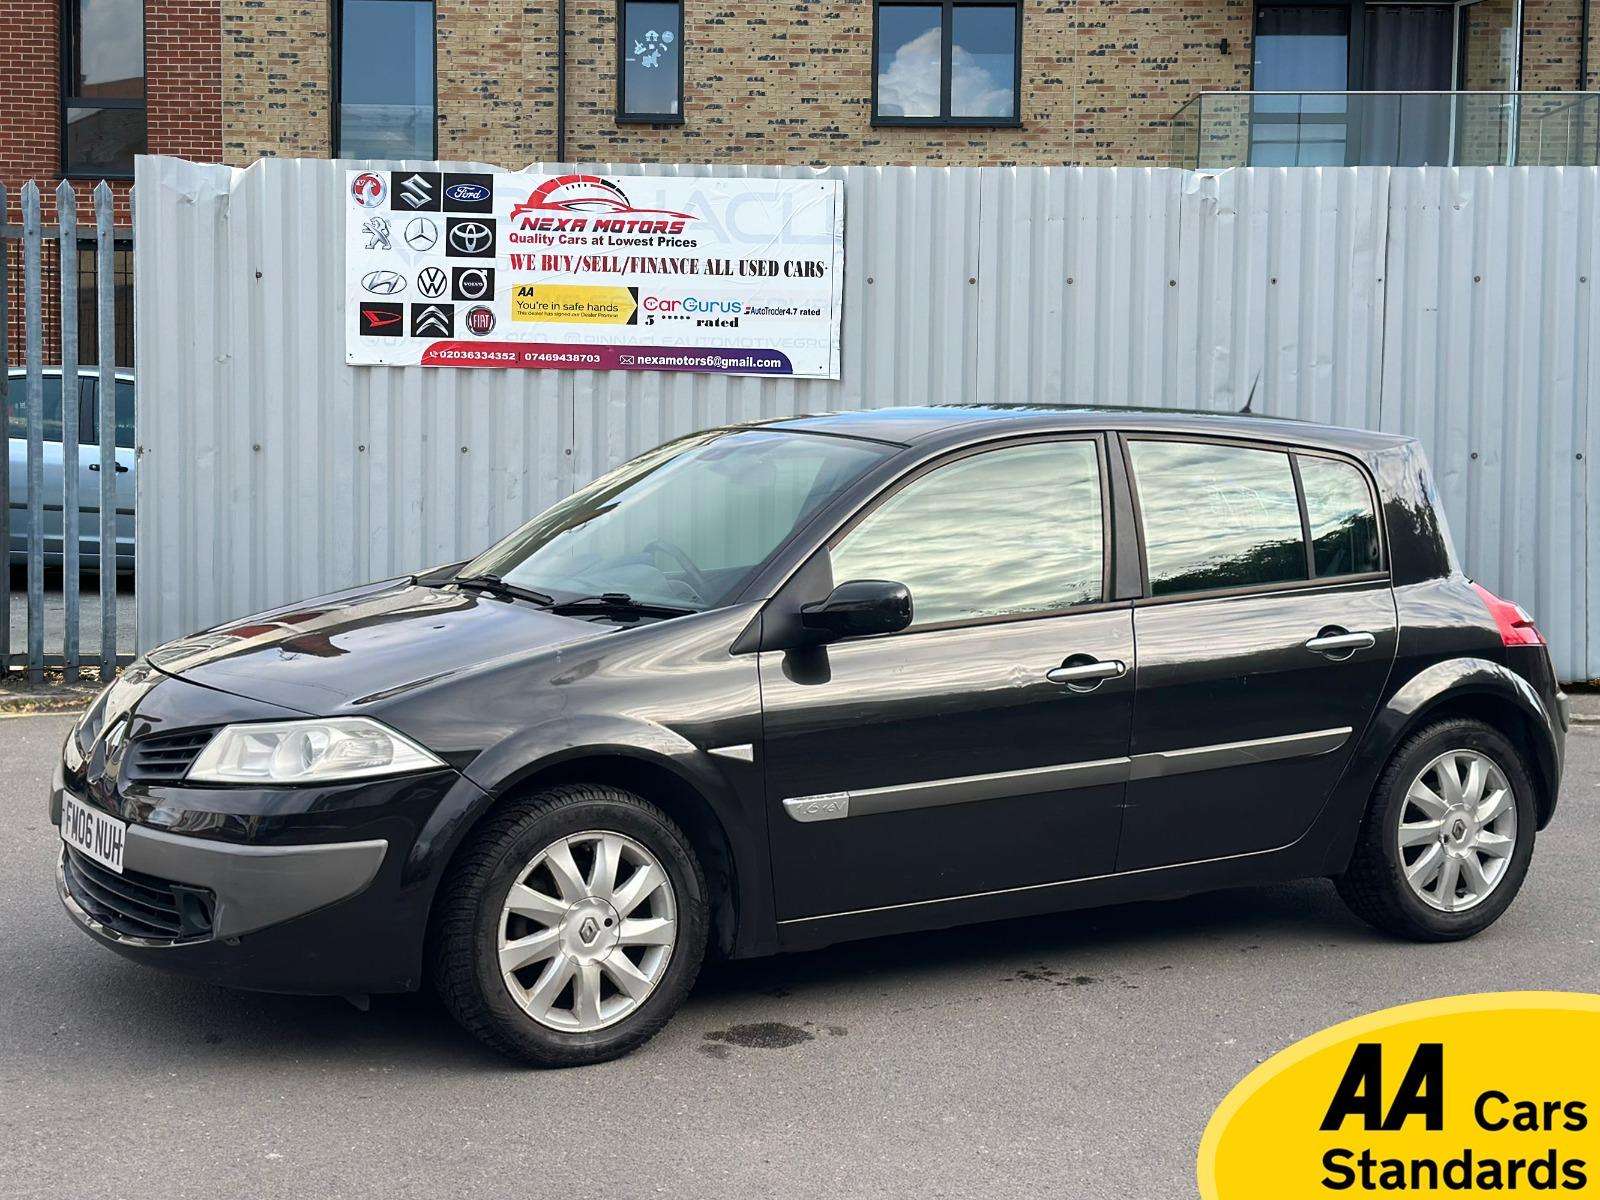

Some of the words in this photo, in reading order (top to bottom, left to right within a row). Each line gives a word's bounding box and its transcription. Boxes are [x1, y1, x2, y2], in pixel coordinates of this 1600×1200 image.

[454, 186, 482, 198] Ford
[520, 217, 588, 232] NEXA
[592, 218, 686, 234] MOTORS
[509, 233, 554, 246] Quality
[558, 234, 588, 245] Cars
[591, 235, 604, 245] at
[608, 235, 653, 246] Lowest
[657, 237, 697, 247] Prices
[510, 254, 536, 271] WE
[541, 254, 699, 276] BUY/SELL/FINANCE
[704, 258, 734, 275] ALL
[739, 259, 780, 277] USED
[784, 260, 825, 278] CARS
[518, 287, 534, 297] AA
[517, 300, 549, 310] You're
[551, 302, 561, 310] in
[563, 302, 585, 311] safe
[587, 303, 619, 312] hands
[643, 296, 742, 313] CarGurus
[800, 308, 821, 316] rated
[473, 314, 490, 328] FIAT
[645, 315, 655, 326] 5
[696, 317, 739, 328] rated
[440, 351, 516, 361] 02036334352
[524, 352, 601, 363] 07469438703
[637, 355, 781, 369] nexamotors6@gmail.com
[66, 800, 93, 849] FM06
[95, 817, 122, 866] NUH
